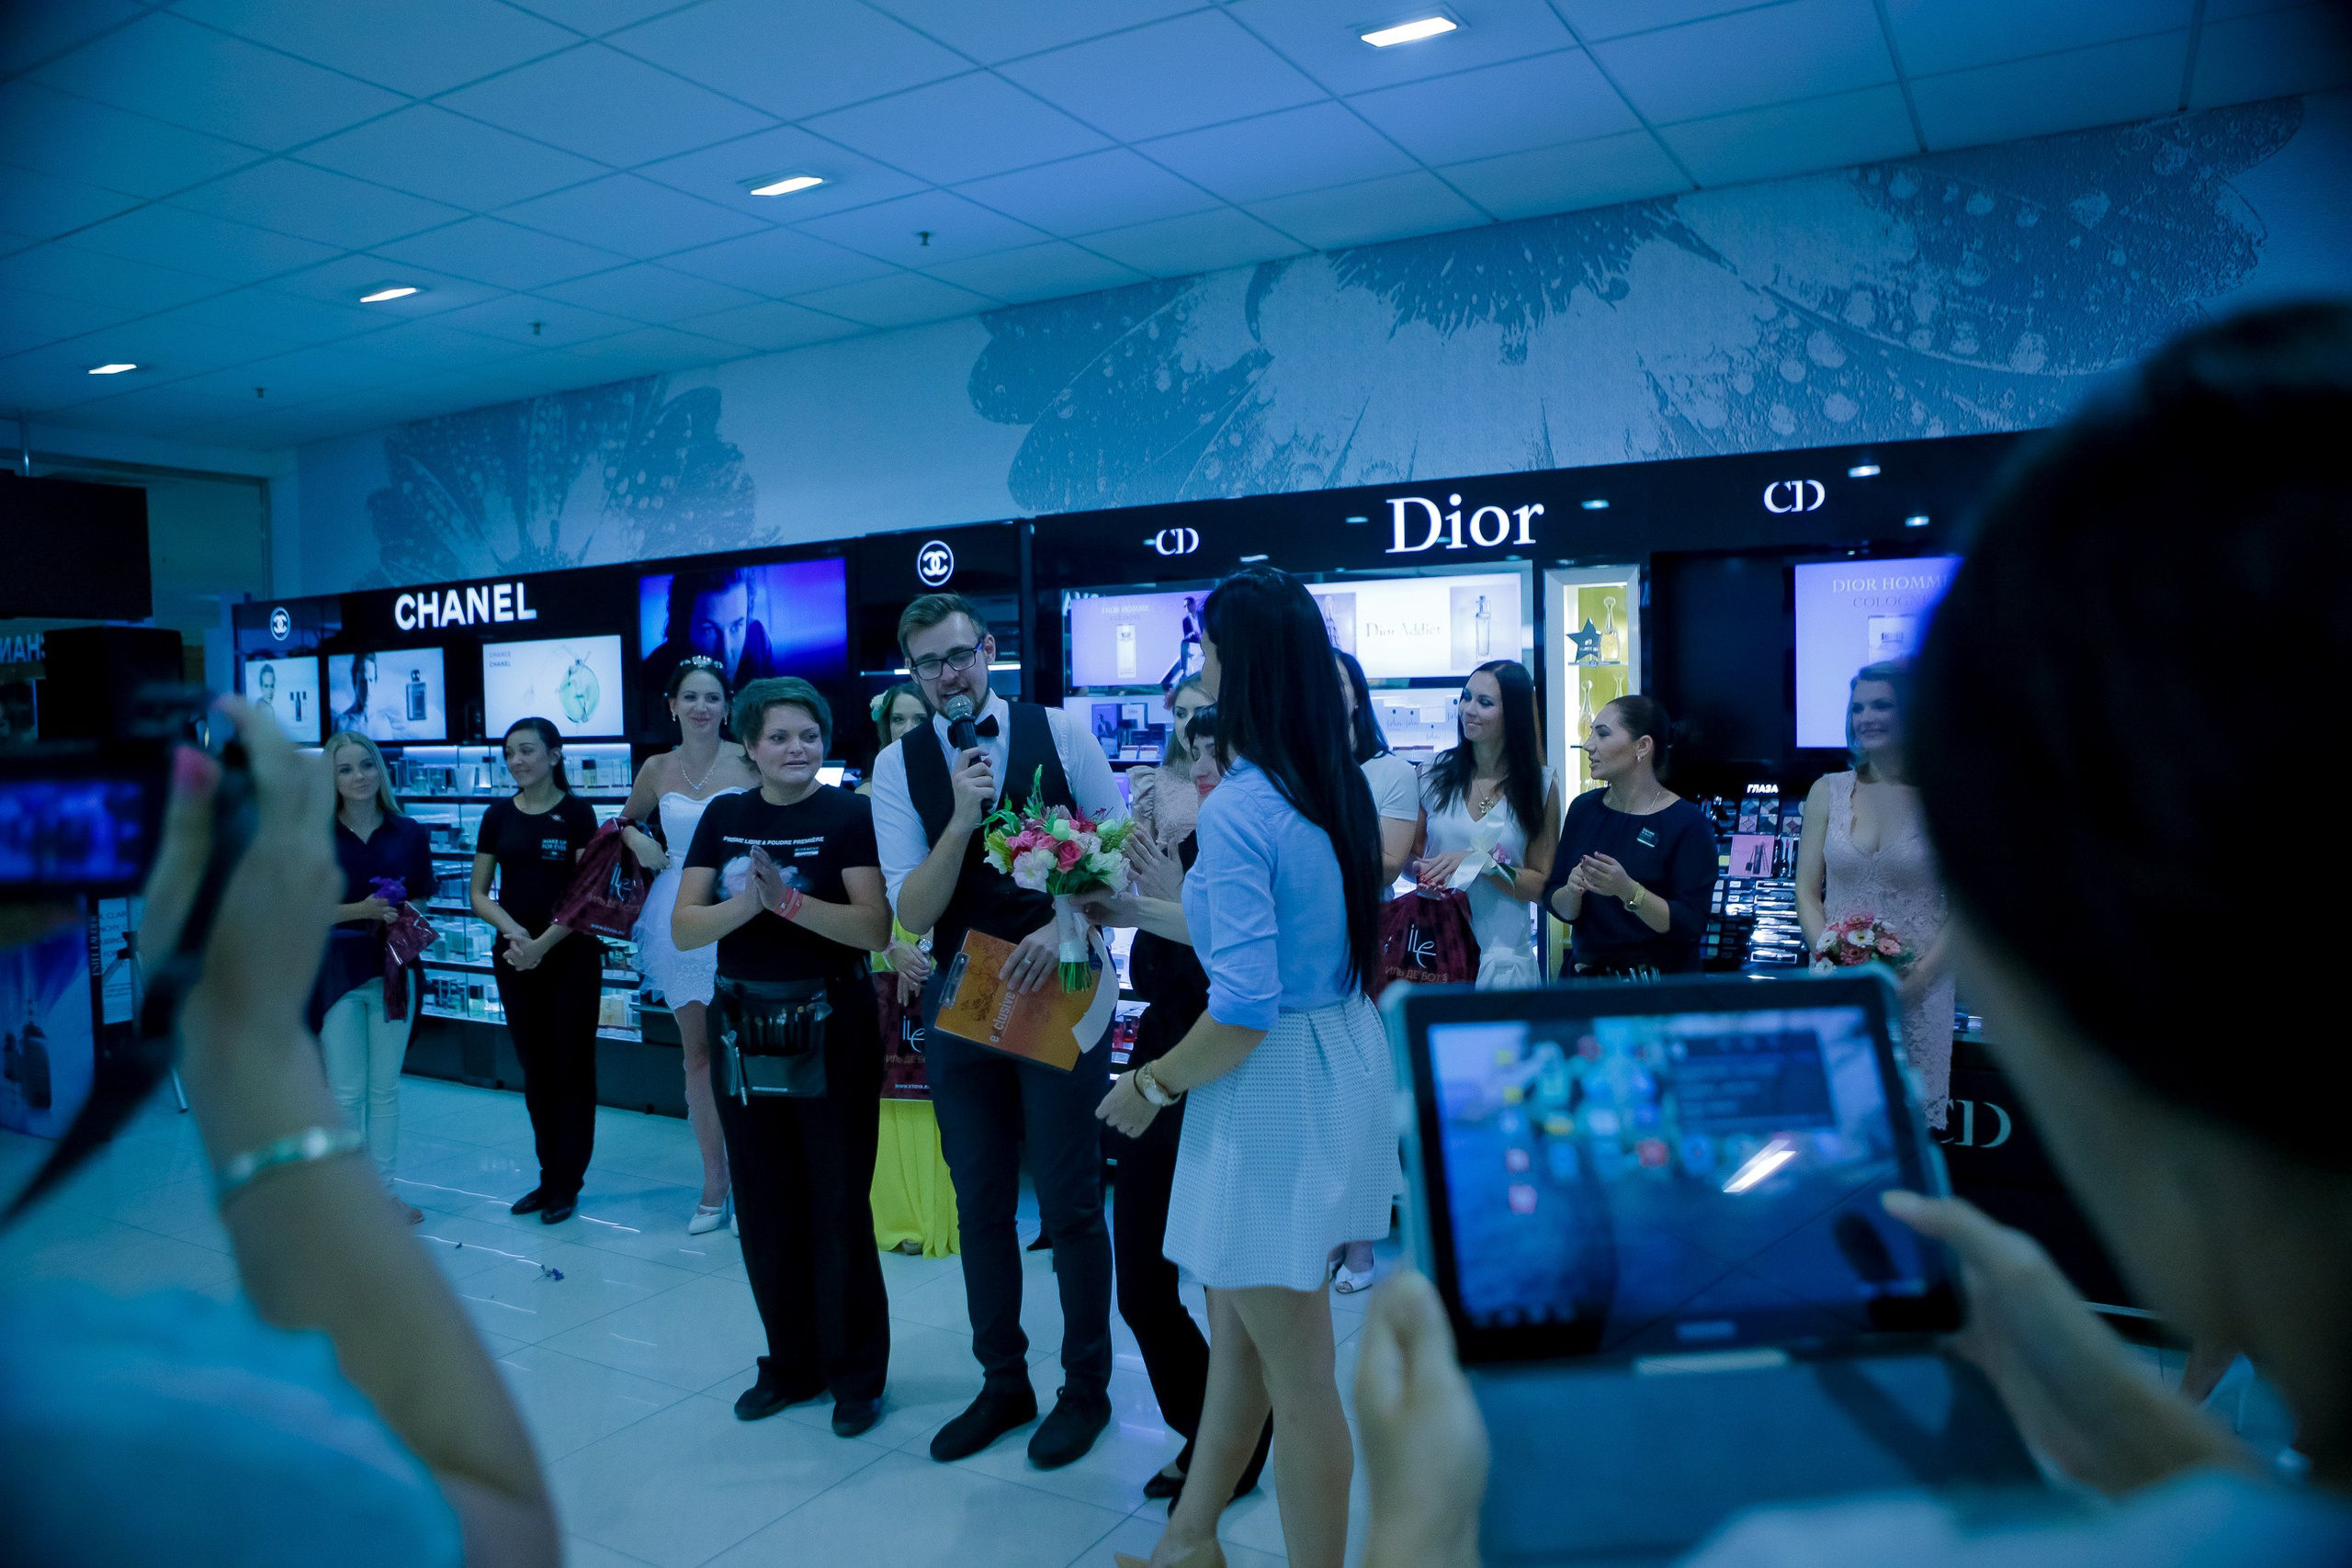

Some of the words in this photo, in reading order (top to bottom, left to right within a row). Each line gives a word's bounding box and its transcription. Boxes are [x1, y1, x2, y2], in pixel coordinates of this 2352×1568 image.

[1385, 493, 1545, 553] Dior
[1832, 578, 1877, 592] DIOR
[395, 582, 537, 631] CHANEL
[1853, 594, 1928, 608] COLOGN
[1366, 623, 1395, 637] Dior
[1747, 784, 1779, 794] ГЛАЗА
